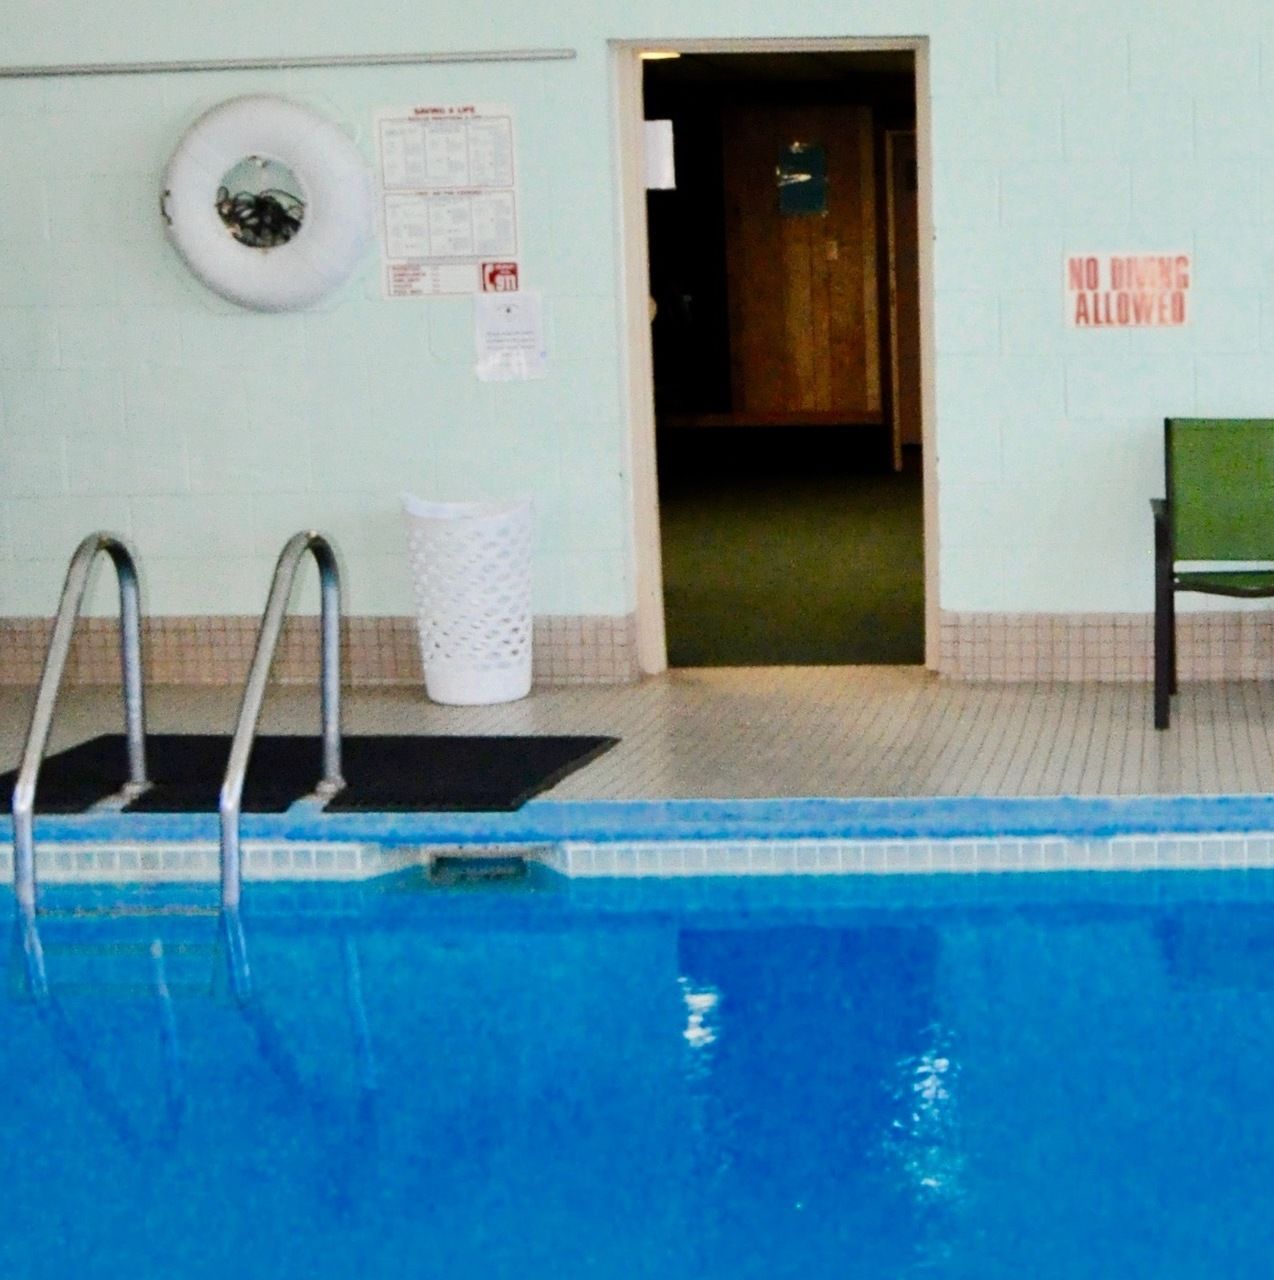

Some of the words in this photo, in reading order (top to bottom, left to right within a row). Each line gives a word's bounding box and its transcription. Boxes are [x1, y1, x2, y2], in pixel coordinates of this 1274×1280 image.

[495, 274, 516, 291] 911
[1069, 256, 1099, 290] NO
[1111, 255, 1189, 290] DIVING
[1076, 291, 1184, 324] ALLOWED
